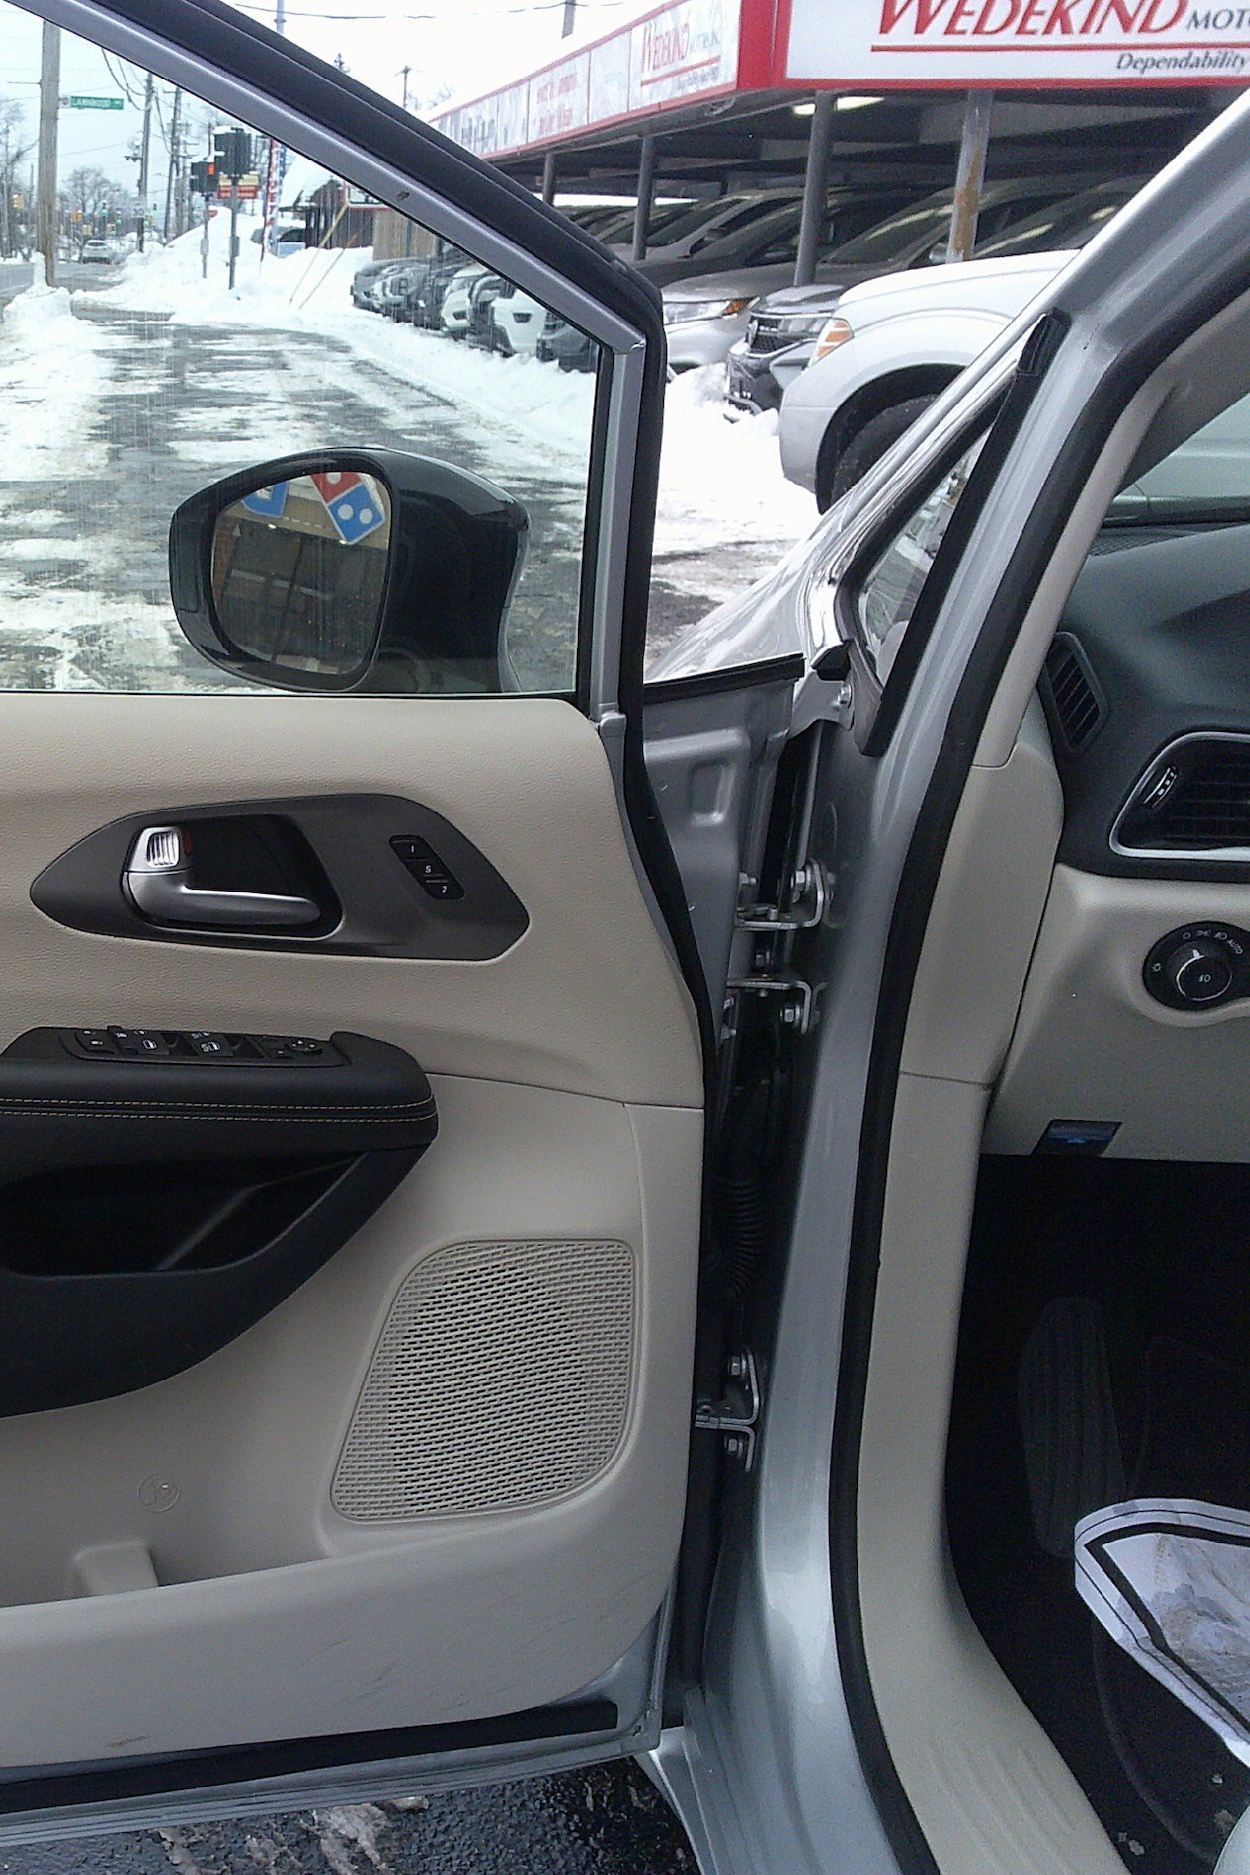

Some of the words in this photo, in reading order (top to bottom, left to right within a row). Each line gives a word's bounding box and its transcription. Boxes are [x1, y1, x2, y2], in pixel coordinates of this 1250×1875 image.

[878, 0, 1188, 35] WEDEKIND
[1185, 8, 1250, 31] MOT
[1116, 51, 1246, 74] Dependability
[425, 864, 432, 874] S
[441, 885, 448, 894] 2
